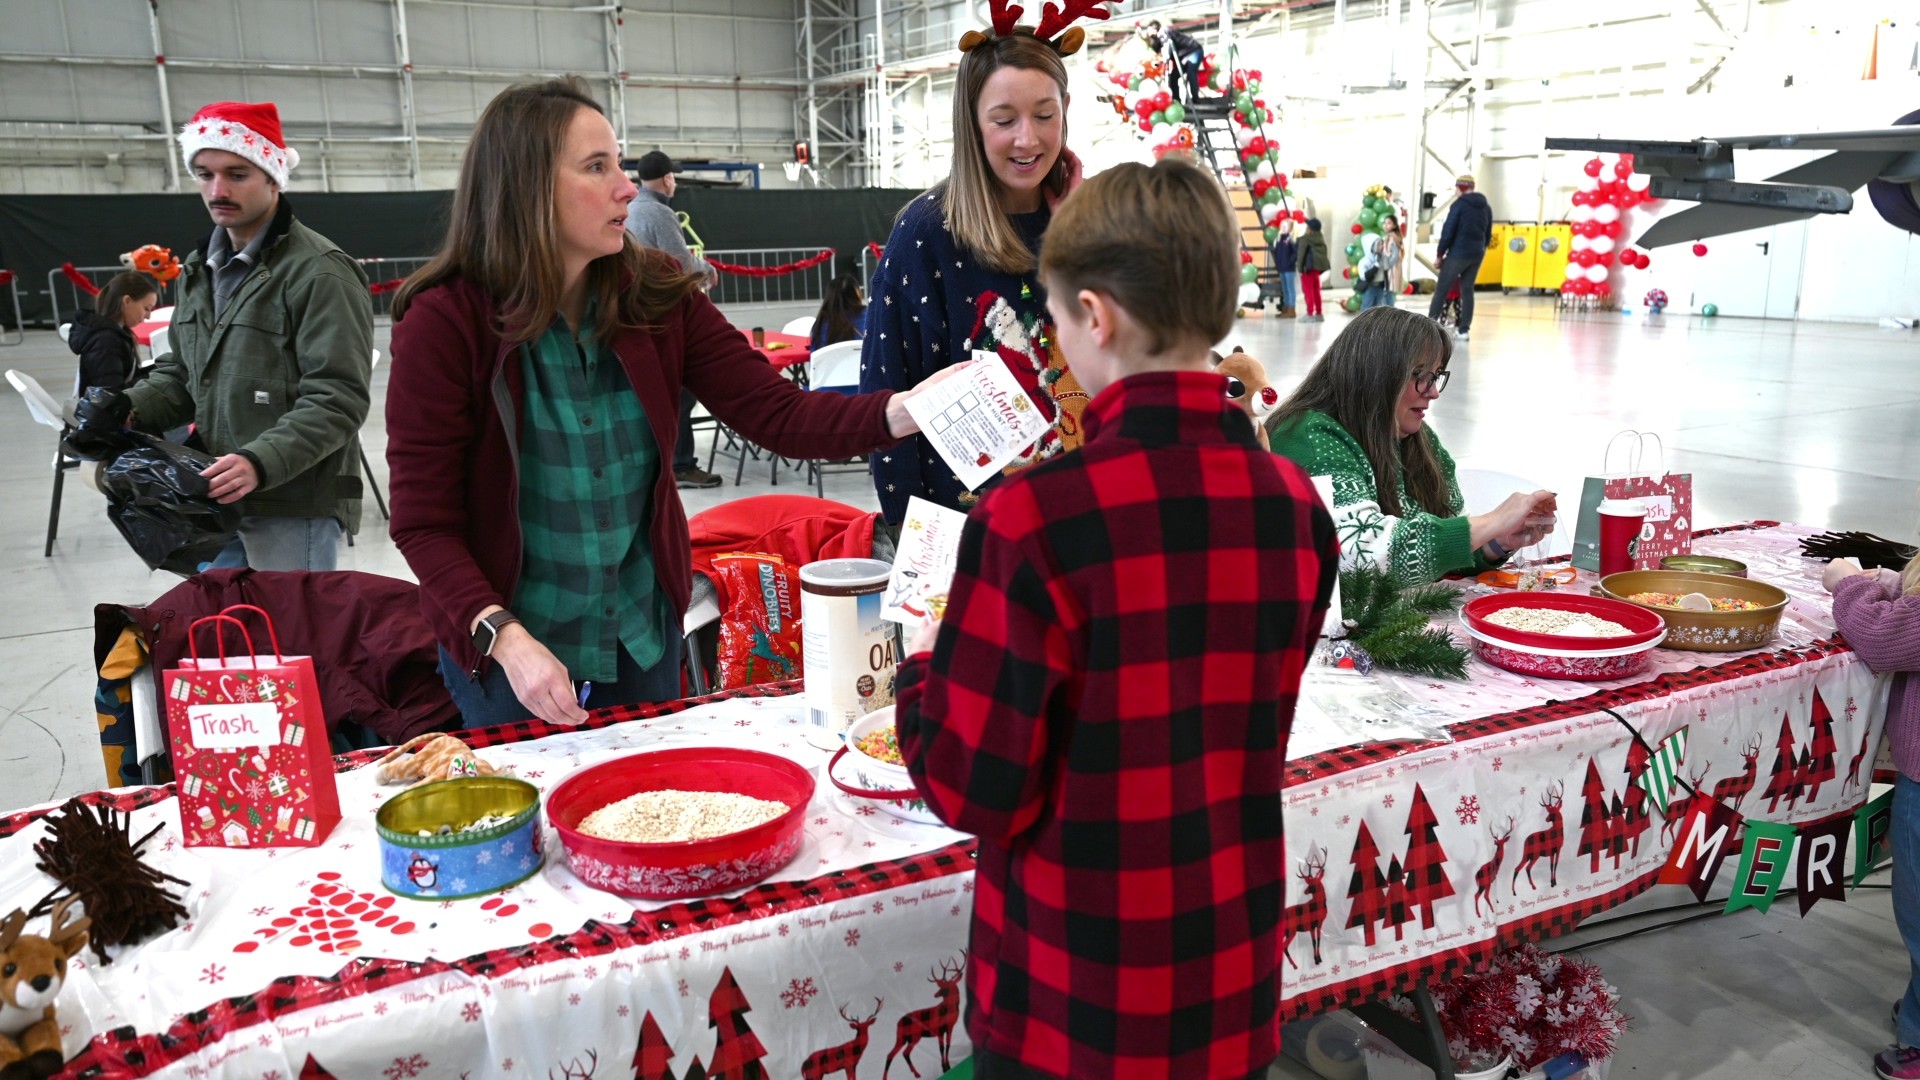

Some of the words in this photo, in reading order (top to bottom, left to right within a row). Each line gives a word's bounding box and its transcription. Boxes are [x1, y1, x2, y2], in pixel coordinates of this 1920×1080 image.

[990, 407, 1006, 427] HUNT
[1645, 504, 1668, 518] ash
[1636, 550, 1668, 559] RISTMAS
[776, 572, 793, 619] FRUITY
[193, 713, 259, 735] Trash
[893, 895, 919, 907] Merry
[922, 887, 956, 901] Christmas
[799, 917, 827, 930] Merry
[829, 908, 867, 923] Christmas
[700, 940, 729, 952] Merry
[731, 930, 771, 946] Christmas
[439, 980, 476, 995] Christm
